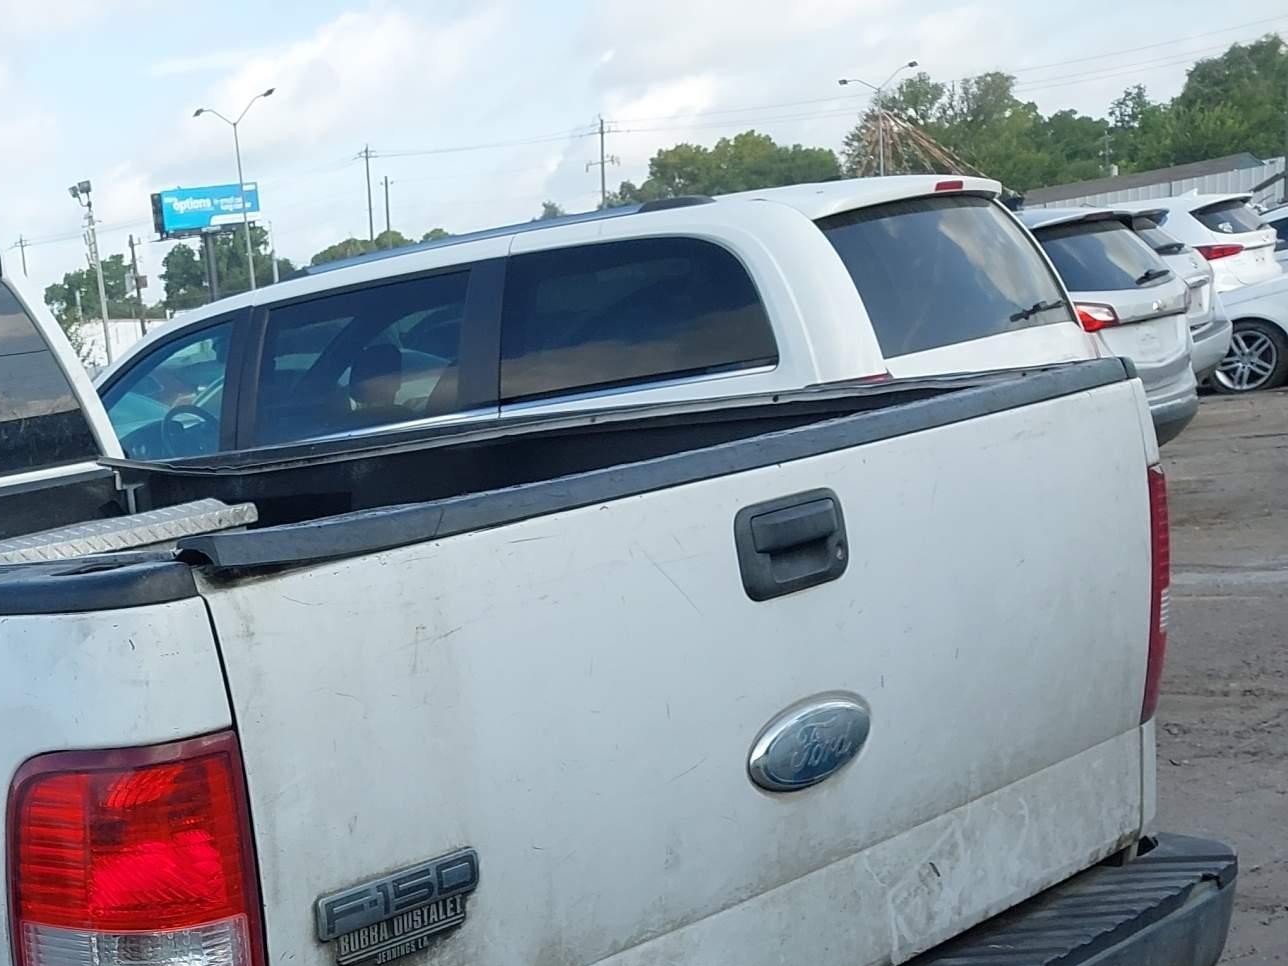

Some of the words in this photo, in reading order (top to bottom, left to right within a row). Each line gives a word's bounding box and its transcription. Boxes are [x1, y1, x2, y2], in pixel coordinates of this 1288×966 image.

[791, 714, 853, 773] Ford
[339, 922, 389, 955] BUBBA
[393, 896, 463, 937] OUSTALET
[376, 941, 416, 964] JENNINGS
